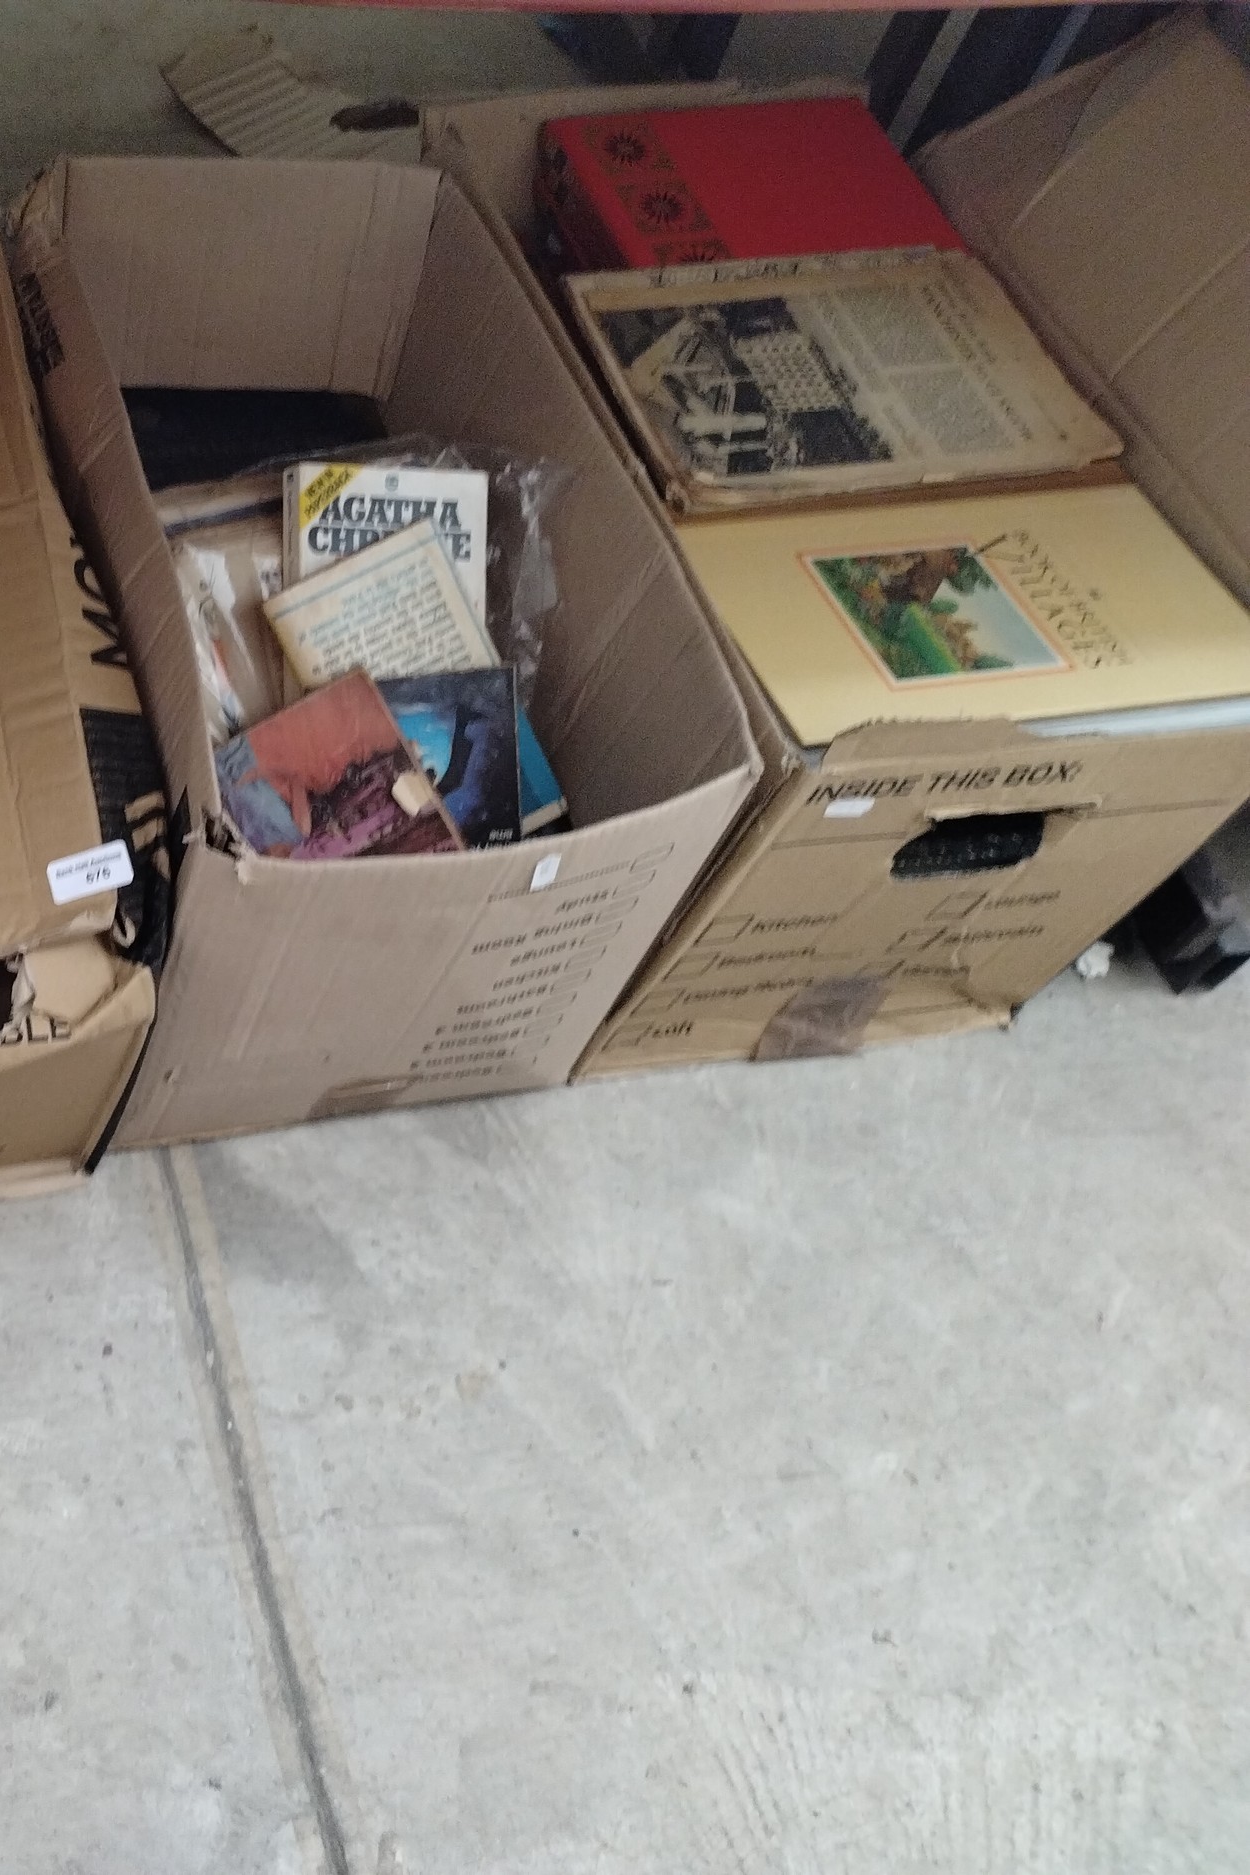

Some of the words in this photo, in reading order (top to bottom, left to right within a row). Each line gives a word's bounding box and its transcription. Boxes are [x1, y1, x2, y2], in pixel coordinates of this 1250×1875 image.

[319, 496, 461, 531] AGATHA
[805, 773, 924, 806] INSIDE
[927, 766, 1000, 796] THIS
